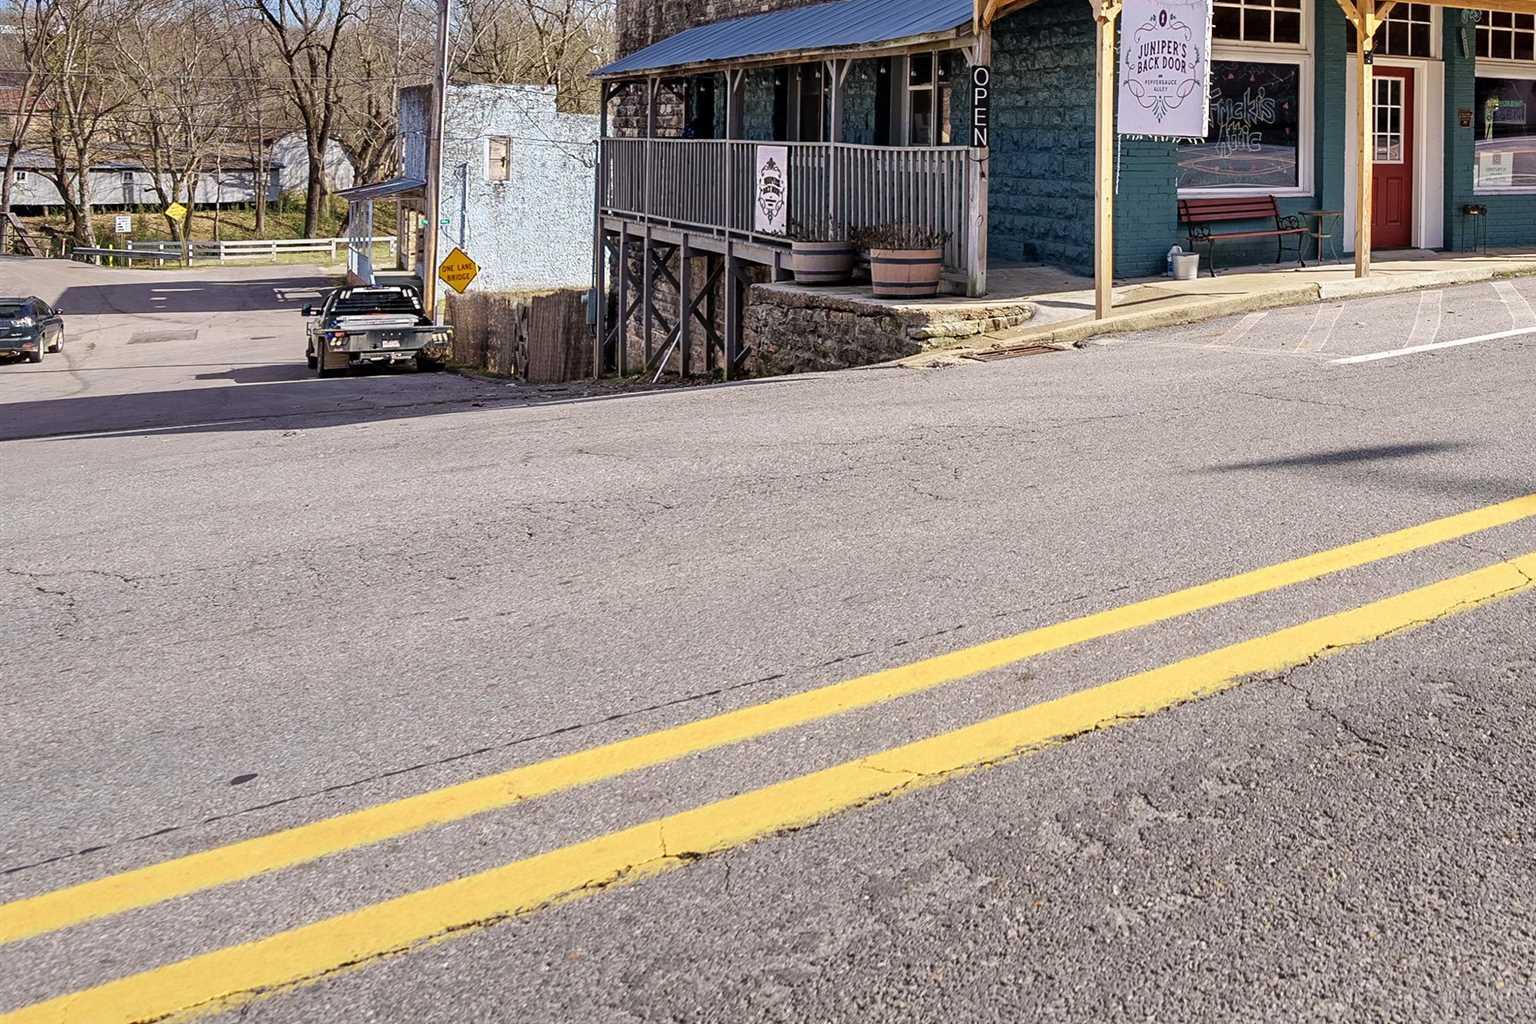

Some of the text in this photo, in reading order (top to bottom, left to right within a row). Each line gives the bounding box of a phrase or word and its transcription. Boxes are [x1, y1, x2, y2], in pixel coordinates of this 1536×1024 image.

[1138, 40, 1187, 59] JUNIPER'S
[1137, 56, 1186, 74] BACK DOOR
[974, 67, 989, 146] OPEN
[447, 273, 470, 281] BRIDGE
